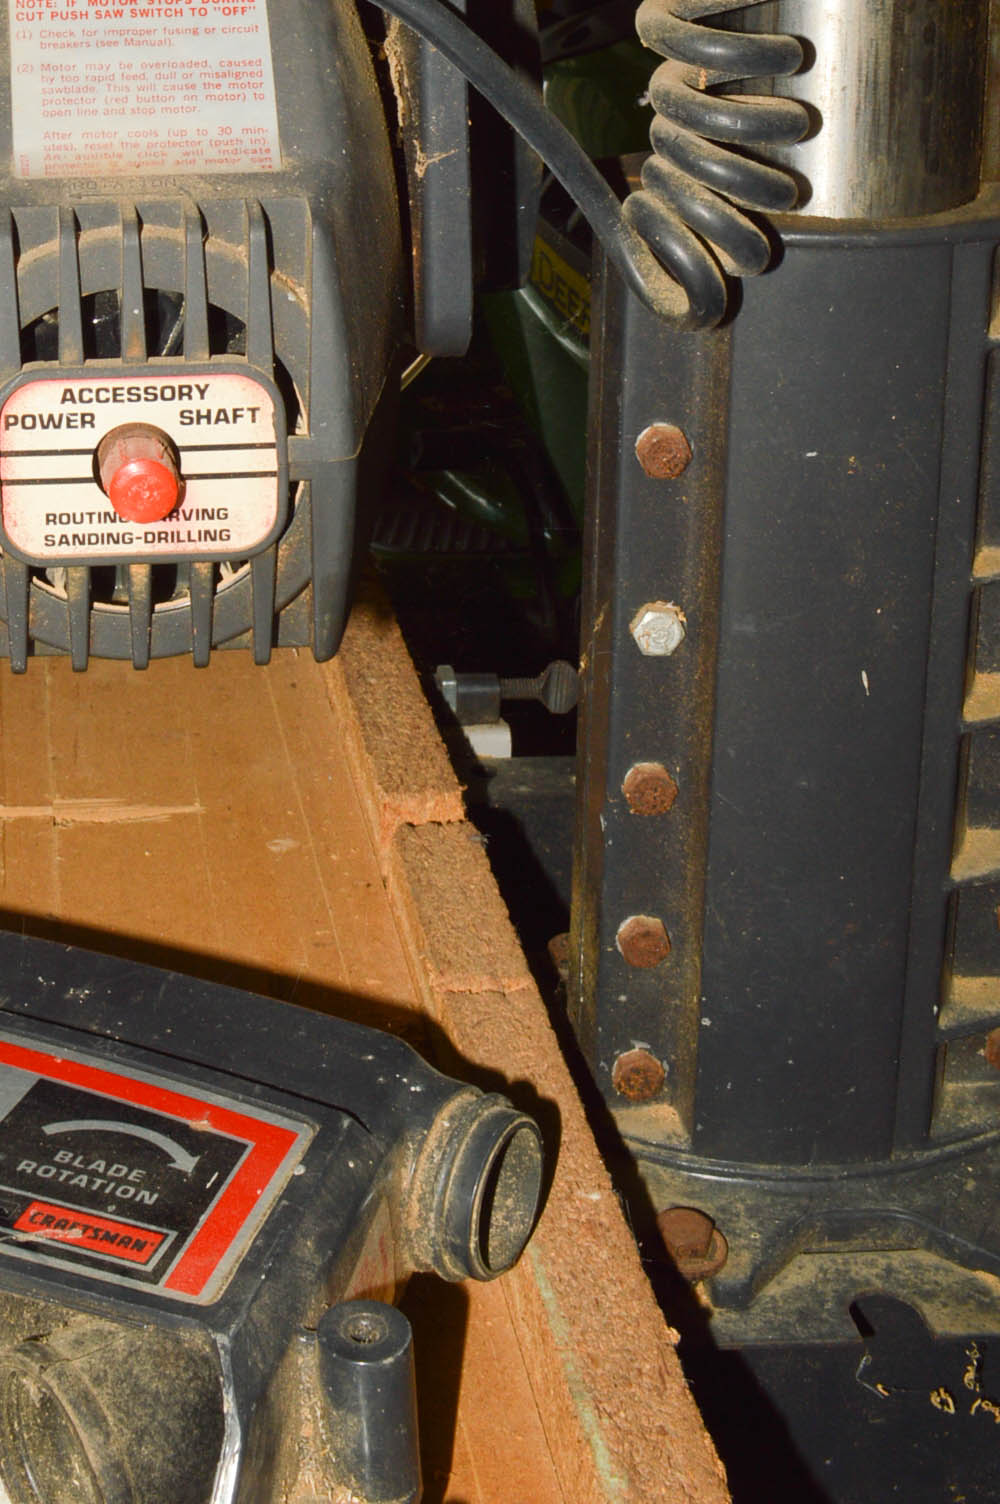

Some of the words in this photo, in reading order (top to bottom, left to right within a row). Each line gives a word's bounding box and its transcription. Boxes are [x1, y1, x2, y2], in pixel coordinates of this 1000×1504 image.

[15, 11, 44, 22] CUT
[50, 10, 89, 21] PUSH
[95, 8, 124, 20] SAW
[129, 7, 184, 19] SWITCH
[188, 7, 208, 17] TO
[39, 29, 77, 39] Check
[82, 28, 98, 37] for
[104, 27, 158, 38] improper
[163, 26, 200, 37] fusing
[204, 26, 217, 34] or
[221, 23, 259, 34] circuit
[39, 40, 91, 50] breakers
[40, 63, 77, 72] Motor
[85, 63, 111, 73] may
[219, 58, 263, 68] caused
[154, 71, 177, 81] dull
[181, 71, 194, 79] or
[199, 69, 263, 81] misaligned
[162, 83, 197, 92] cause
[202, 81, 222, 90] the
[228, 80, 264, 90] motor
[135, 94, 176, 104] button
[253, 91, 265, 101] to
[217, 125, 233, 136] 30
[60, 383, 211, 405] ACCESSORY
[4, 412, 96, 431] POWER
[179, 407, 261, 426] SHAFT
[44, 528, 231, 547] SANDING-DRILLING
[53, 1149, 147, 1183] BLADE
[16, 1159, 160, 1206] ROTATION
